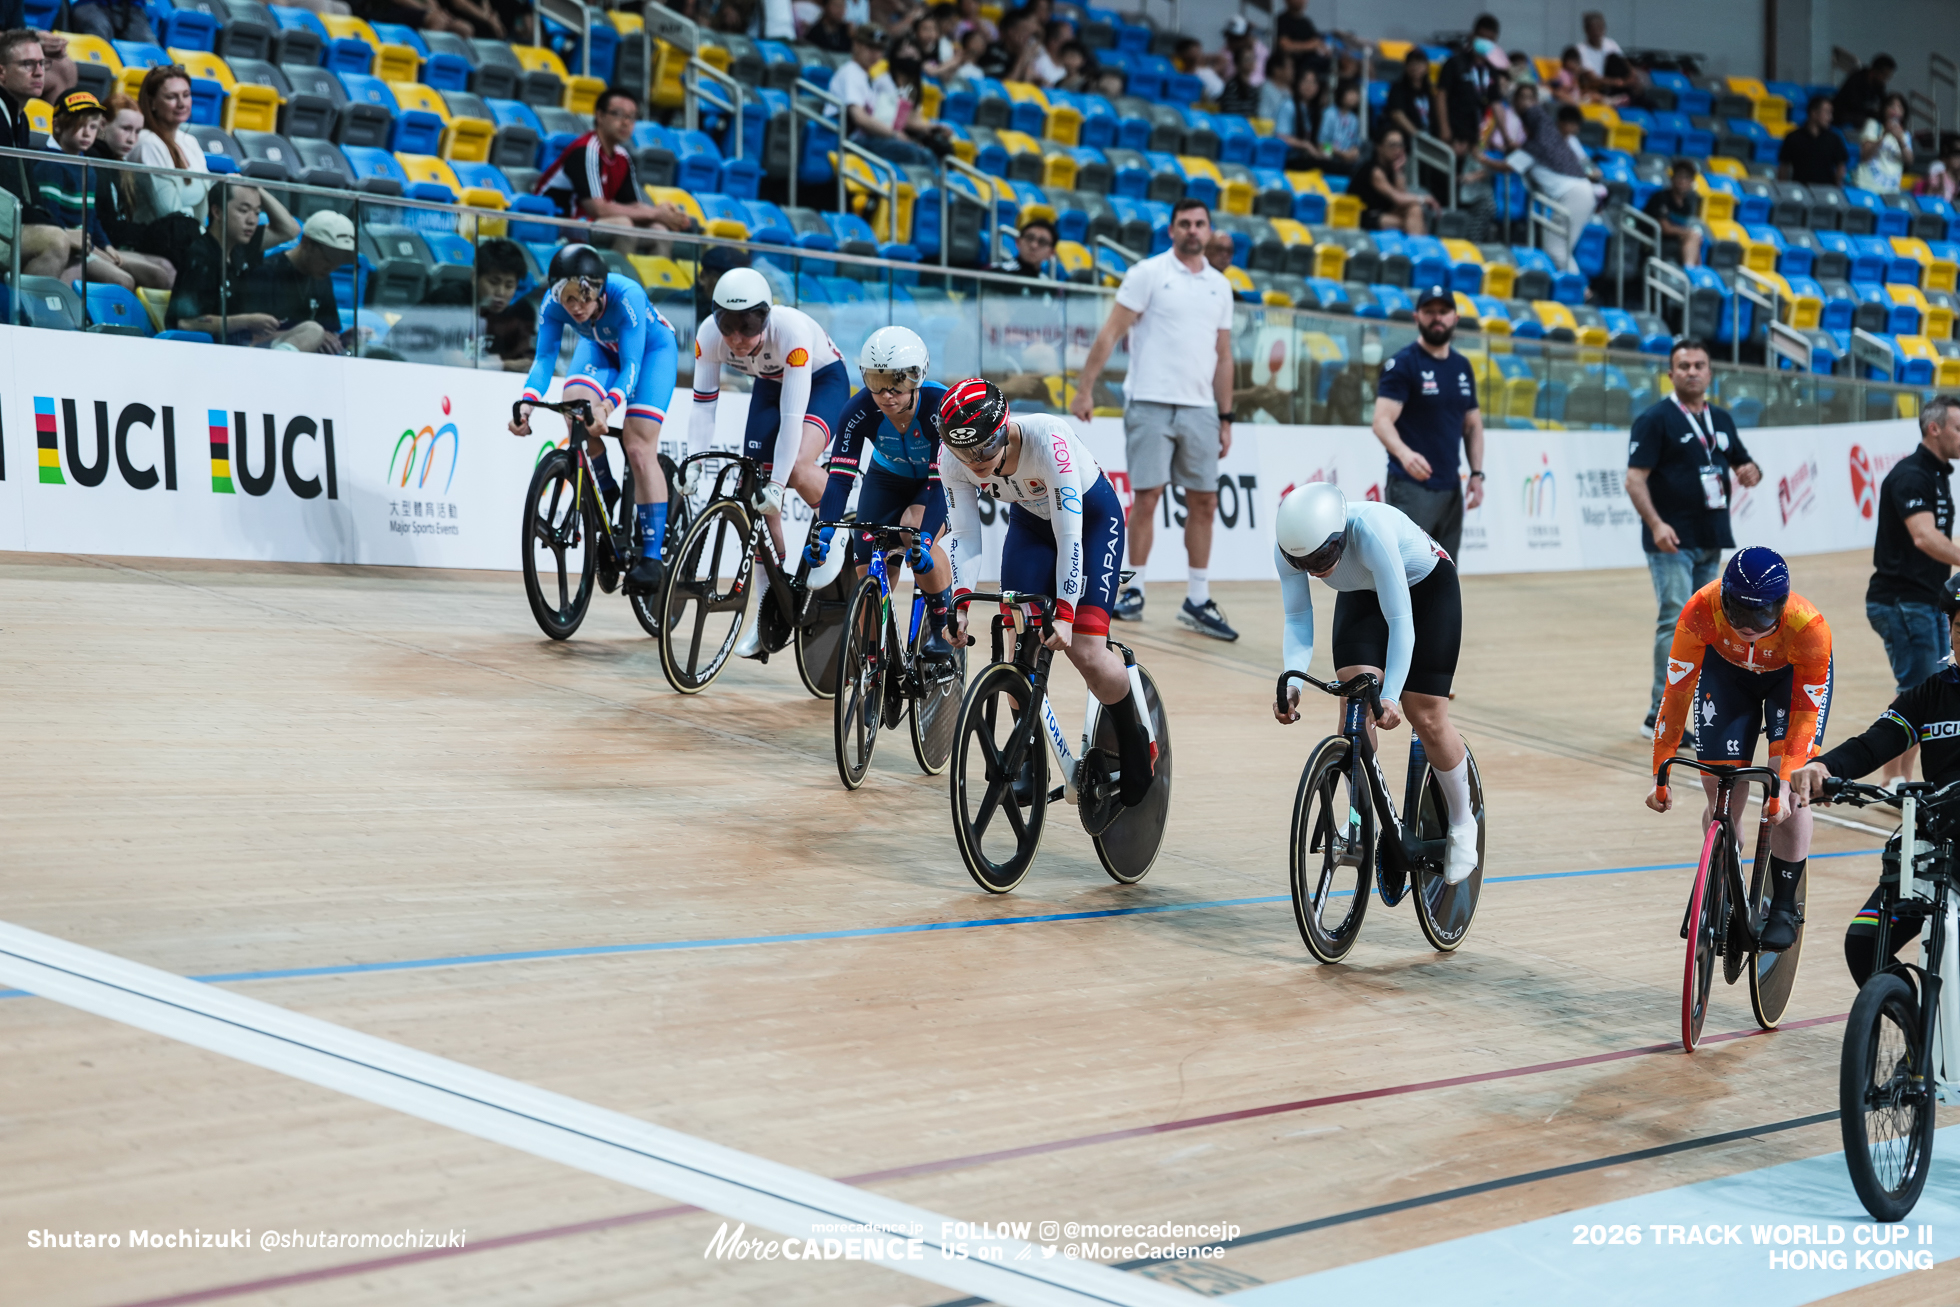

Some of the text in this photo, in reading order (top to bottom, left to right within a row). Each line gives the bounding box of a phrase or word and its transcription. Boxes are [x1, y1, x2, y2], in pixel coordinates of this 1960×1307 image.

[61, 397, 179, 492] UCI
[841, 409, 867, 453] CASTELLI
[234, 410, 339, 501] UCI
[389, 520, 459, 536] Major Sports Events
[737, 518, 761, 584] LOTUS
[1069, 541, 1080, 578] Cyclers
[1099, 516, 1119, 603] JAPAN
[1352, 703, 1360, 730] KOGA
[1931, 723, 1958, 738] UCI
[1723, 788, 1731, 816] KOGA
